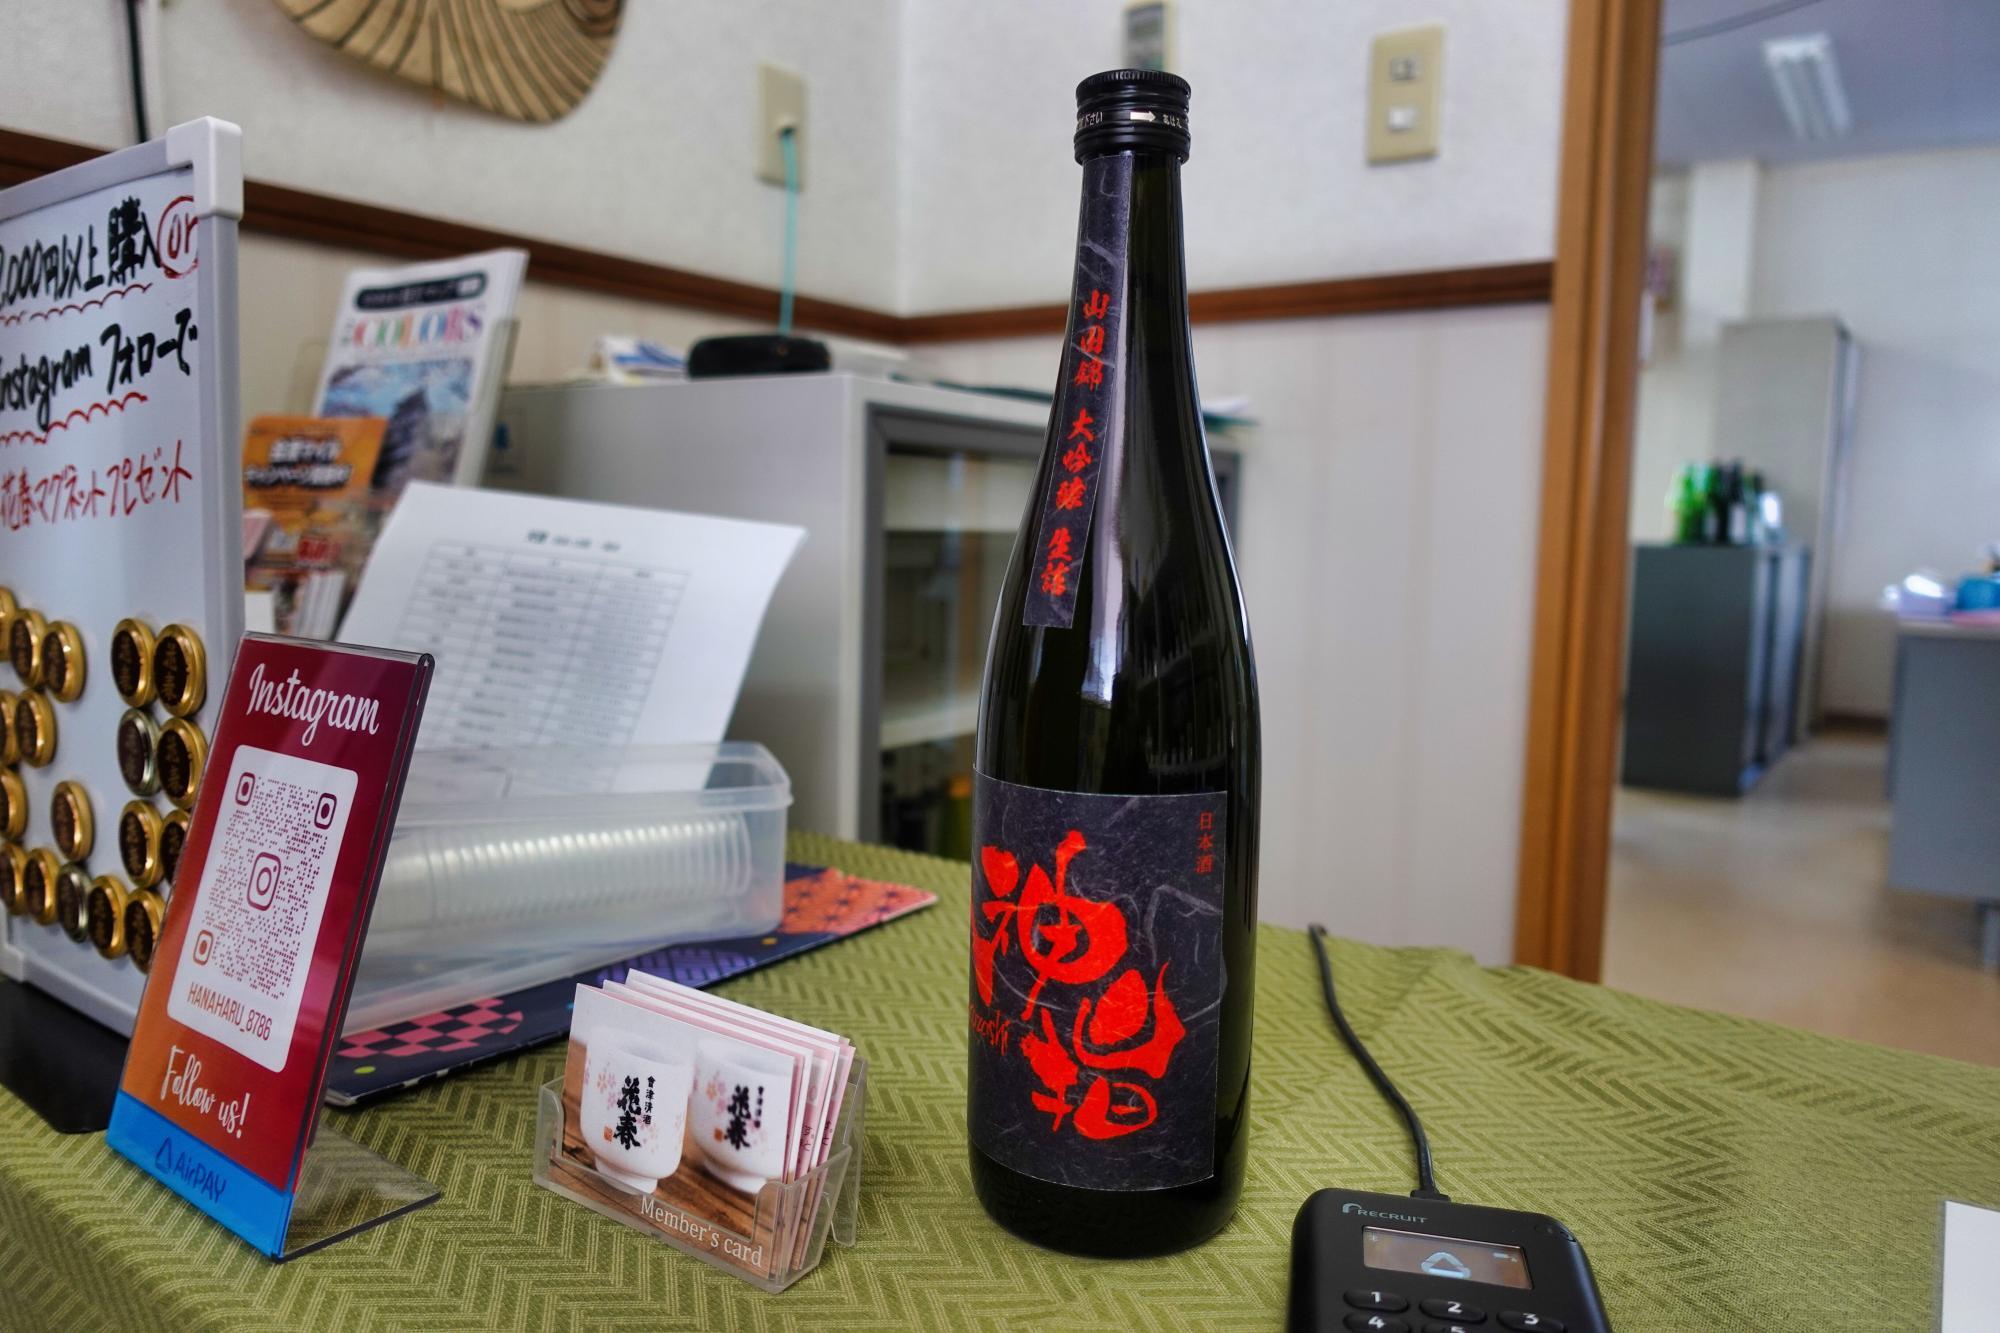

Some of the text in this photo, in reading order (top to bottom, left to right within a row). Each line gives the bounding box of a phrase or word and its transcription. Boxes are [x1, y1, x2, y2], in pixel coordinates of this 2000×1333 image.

[167, 213, 199, 259] or
[0, 307, 198, 432] nstagram フォローで
[1074, 289, 1110, 391] 山田錦
[1056, 408, 1095, 511] 大吟醸
[247, 662, 380, 747] Instagram
[1195, 809, 1214, 874] 日本酒
[187, 981, 273, 1041] HANAHARU_8786
[160, 1045, 251, 1139] Follow us!
[613, 1075, 643, 1150] 花春
[640, 1195, 763, 1268] Member's card
[1357, 1209, 1428, 1224] RECRUIT
[1368, 1315, 1386, 1329] 4
[1370, 1291, 1540, 1326] 1 2 3
